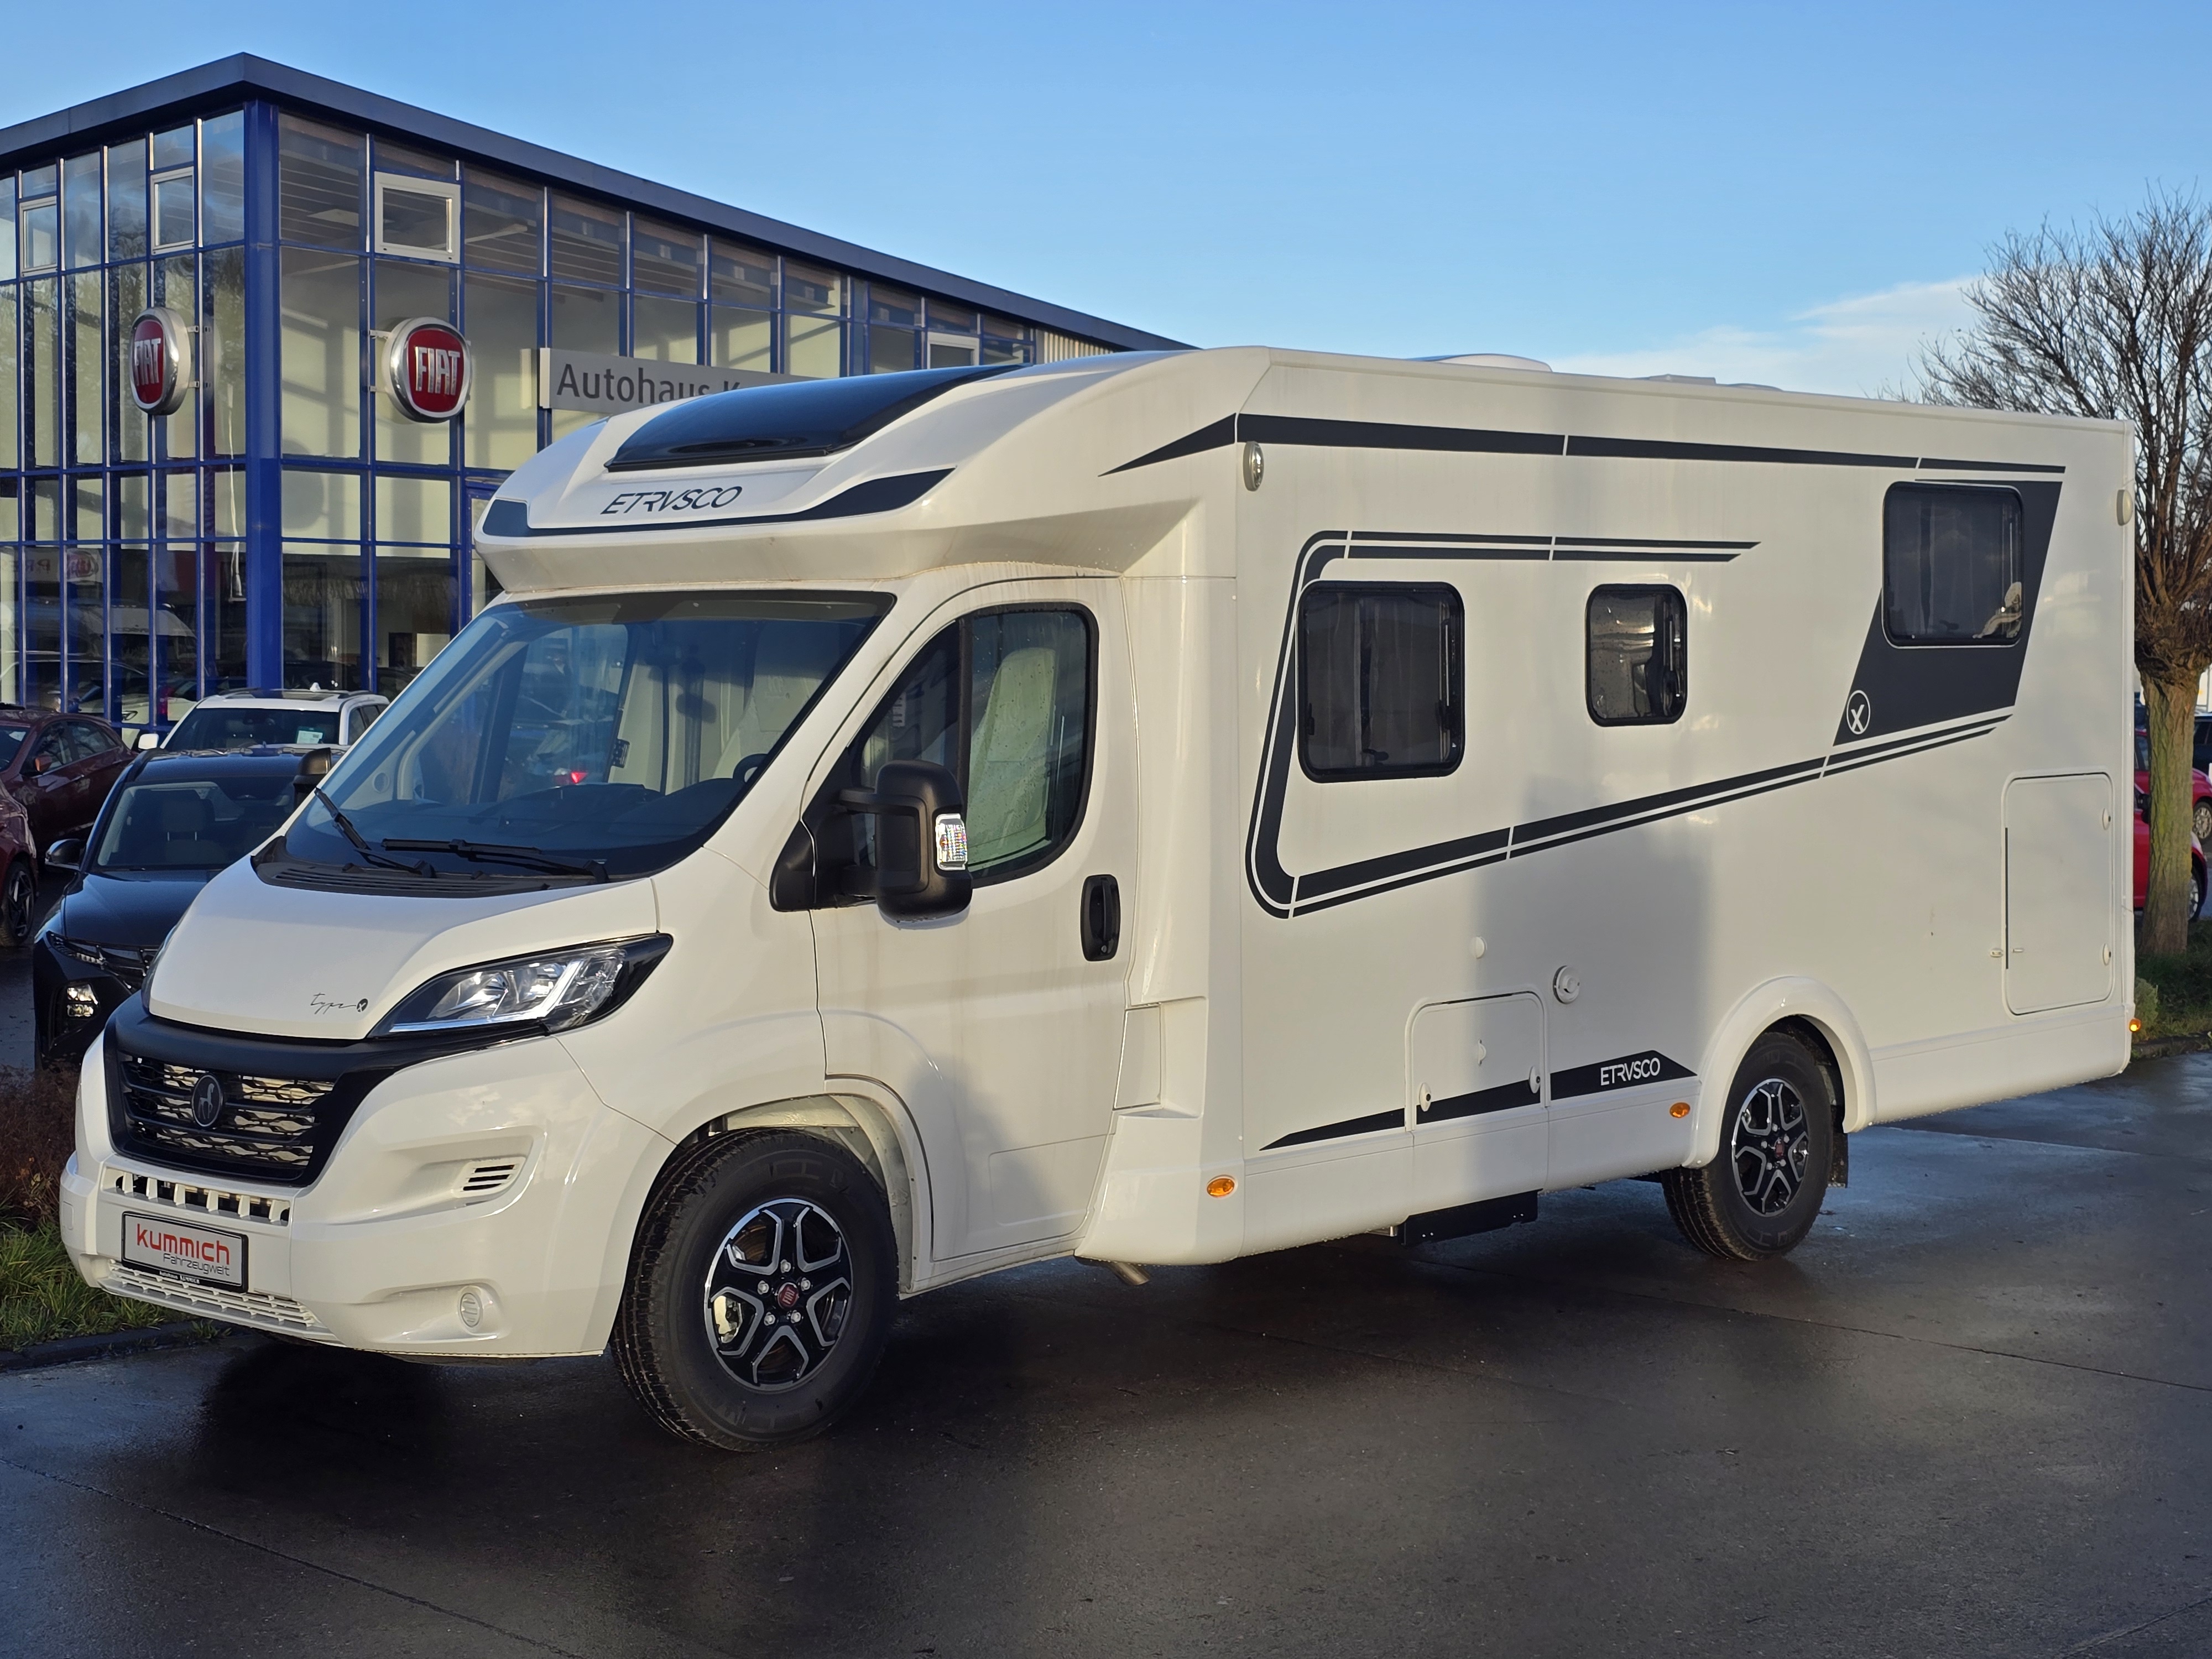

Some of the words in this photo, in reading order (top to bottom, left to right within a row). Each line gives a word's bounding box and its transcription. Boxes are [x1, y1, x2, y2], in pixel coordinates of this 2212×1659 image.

[134, 337, 161, 387] FIAT
[415, 346, 461, 396] FIAT
[163, 1253, 230, 1276] Fahrzeugwelt
[782, 1286, 795, 1305] FIAT
